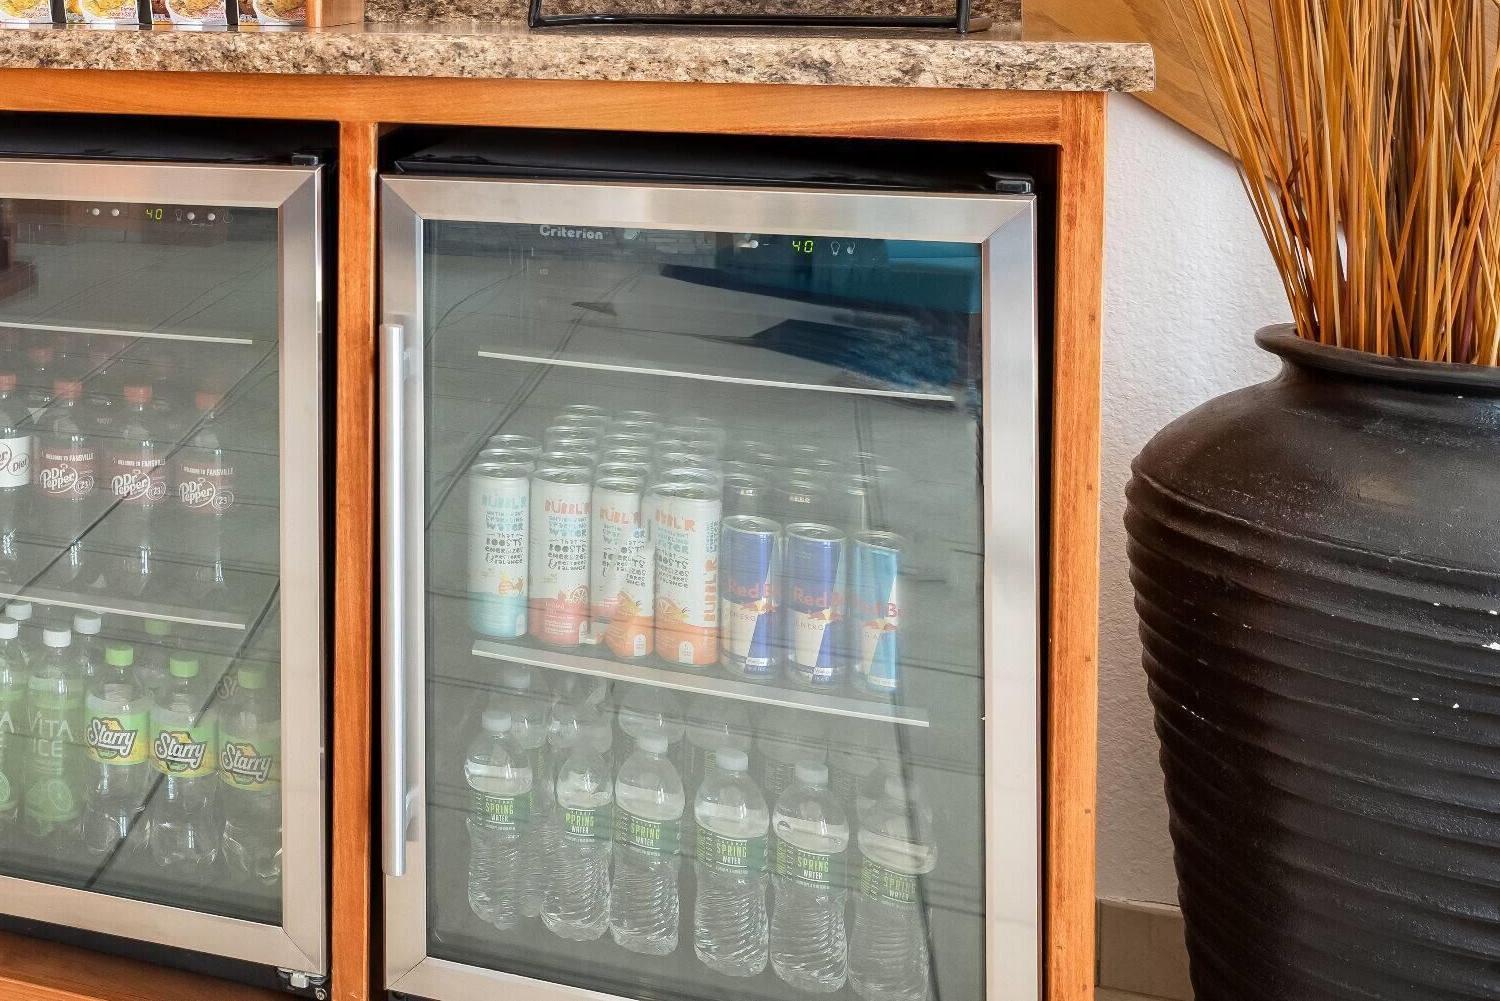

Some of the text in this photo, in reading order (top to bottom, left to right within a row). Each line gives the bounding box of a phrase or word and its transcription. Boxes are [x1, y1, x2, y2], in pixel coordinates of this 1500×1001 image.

[146, 208, 163, 221] 40
[539, 223, 603, 241] Criterion
[792, 239, 814, 255] 40
[12, 459, 27, 472] Diet
[51, 467, 66, 479] Dr
[40, 468, 76, 490] Pepper
[112, 474, 148, 496] Pepper
[123, 473, 138, 485] Dr
[189, 480, 203, 492] Dr
[179, 481, 214, 504] Pepper
[87, 718, 138, 757] Starry
[32, 737, 63, 758] ICE
[154, 732, 207, 769] Starry
[221, 743, 273, 781] Starry
[485, 803, 514, 815] SPRING
[491, 814, 509, 823] WATER
[630, 825, 660, 840] SPRING
[635, 836, 654, 847] WATER
[716, 845, 747, 858] SPRING
[722, 856, 741, 865] WATER
[797, 856, 829, 873] SPRING
[803, 870, 823, 880] WATER
[883, 877, 916, 894] SPRING
